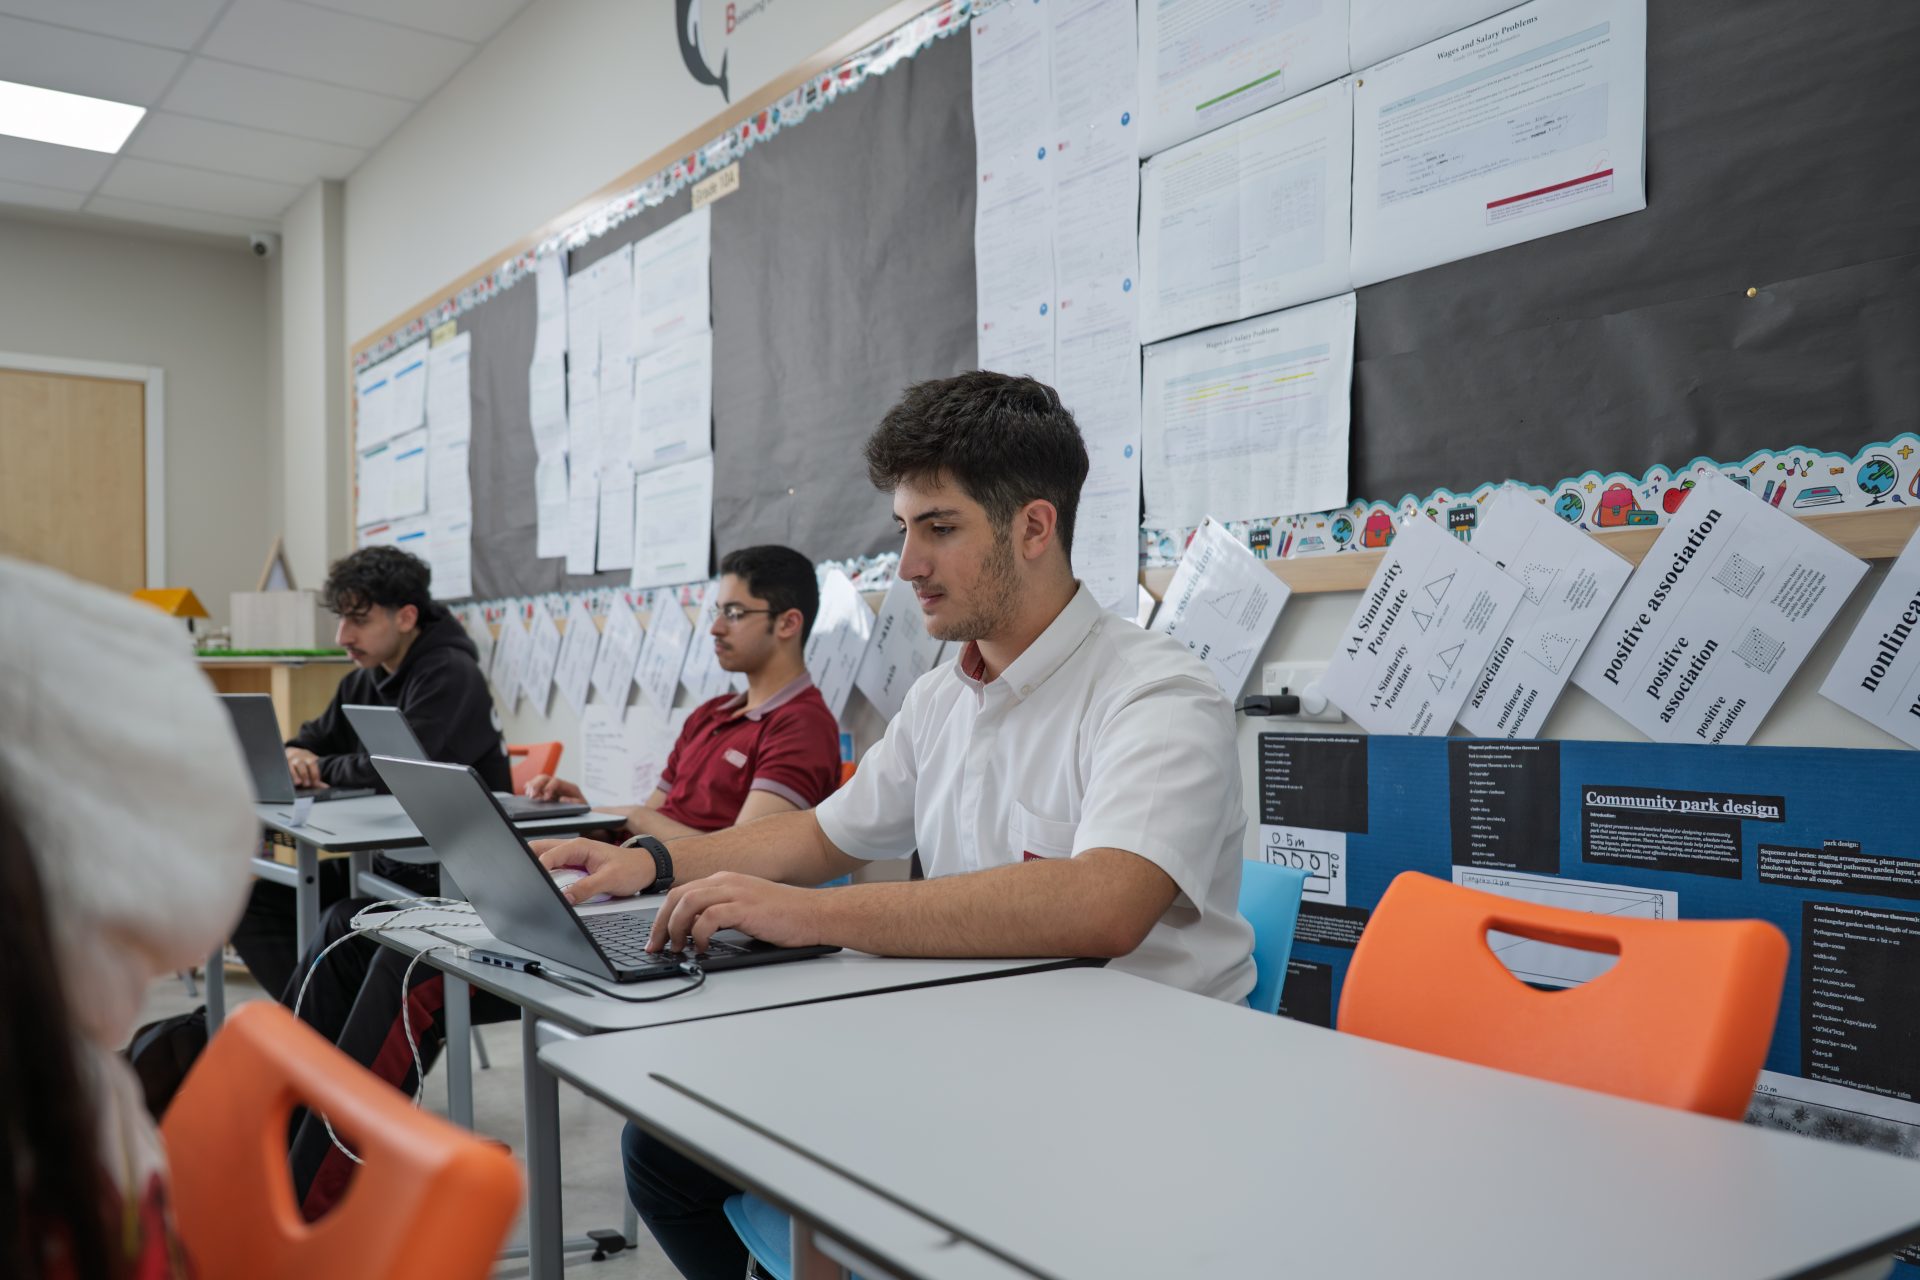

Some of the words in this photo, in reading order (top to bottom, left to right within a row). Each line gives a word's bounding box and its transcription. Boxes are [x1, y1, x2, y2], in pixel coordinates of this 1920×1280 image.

[1437, 47, 1459, 60] Wages
[1461, 40, 1474, 50] and
[1476, 31, 1500, 43] Salary
[1502, 16, 1538, 34] Problems
[1346, 636, 1364, 660] AA
[1358, 560, 1402, 633] Similarity
[1602, 611, 1652, 685] positive
[1648, 507, 1722, 612] association
[1367, 589, 1408, 656] Postulate
[1370, 694, 1382, 712] AA
[1378, 644, 1408, 694] Similarity
[1384, 664, 1412, 710] Postulate
[1472, 635, 1514, 709] association
[1646, 636, 1689, 700] positive
[1660, 638, 1718, 724] association
[1411, 700, 1430, 730] Similarity
[1497, 682, 1525, 729] nonlinear
[1508, 688, 1539, 740] association
[1696, 696, 1726, 738] positive
[1586, 792, 1677, 812] Community
[1680, 798, 1719, 812] park
[1723, 800, 1780, 818] design
[1761, 856, 1790, 864] Pythagoras
[1818, 861, 1842, 869] diagonal
[1844, 864, 1872, 872] pathways,
[1896, 868, 1916, 876] layout,
[1838, 840, 1859, 848] design:
[1761, 871, 1792, 879] integration:
[1802, 867, 1821, 875] budget
[1822, 870, 1850, 878] tolerance,
[1852, 873, 1891, 881] measurement
